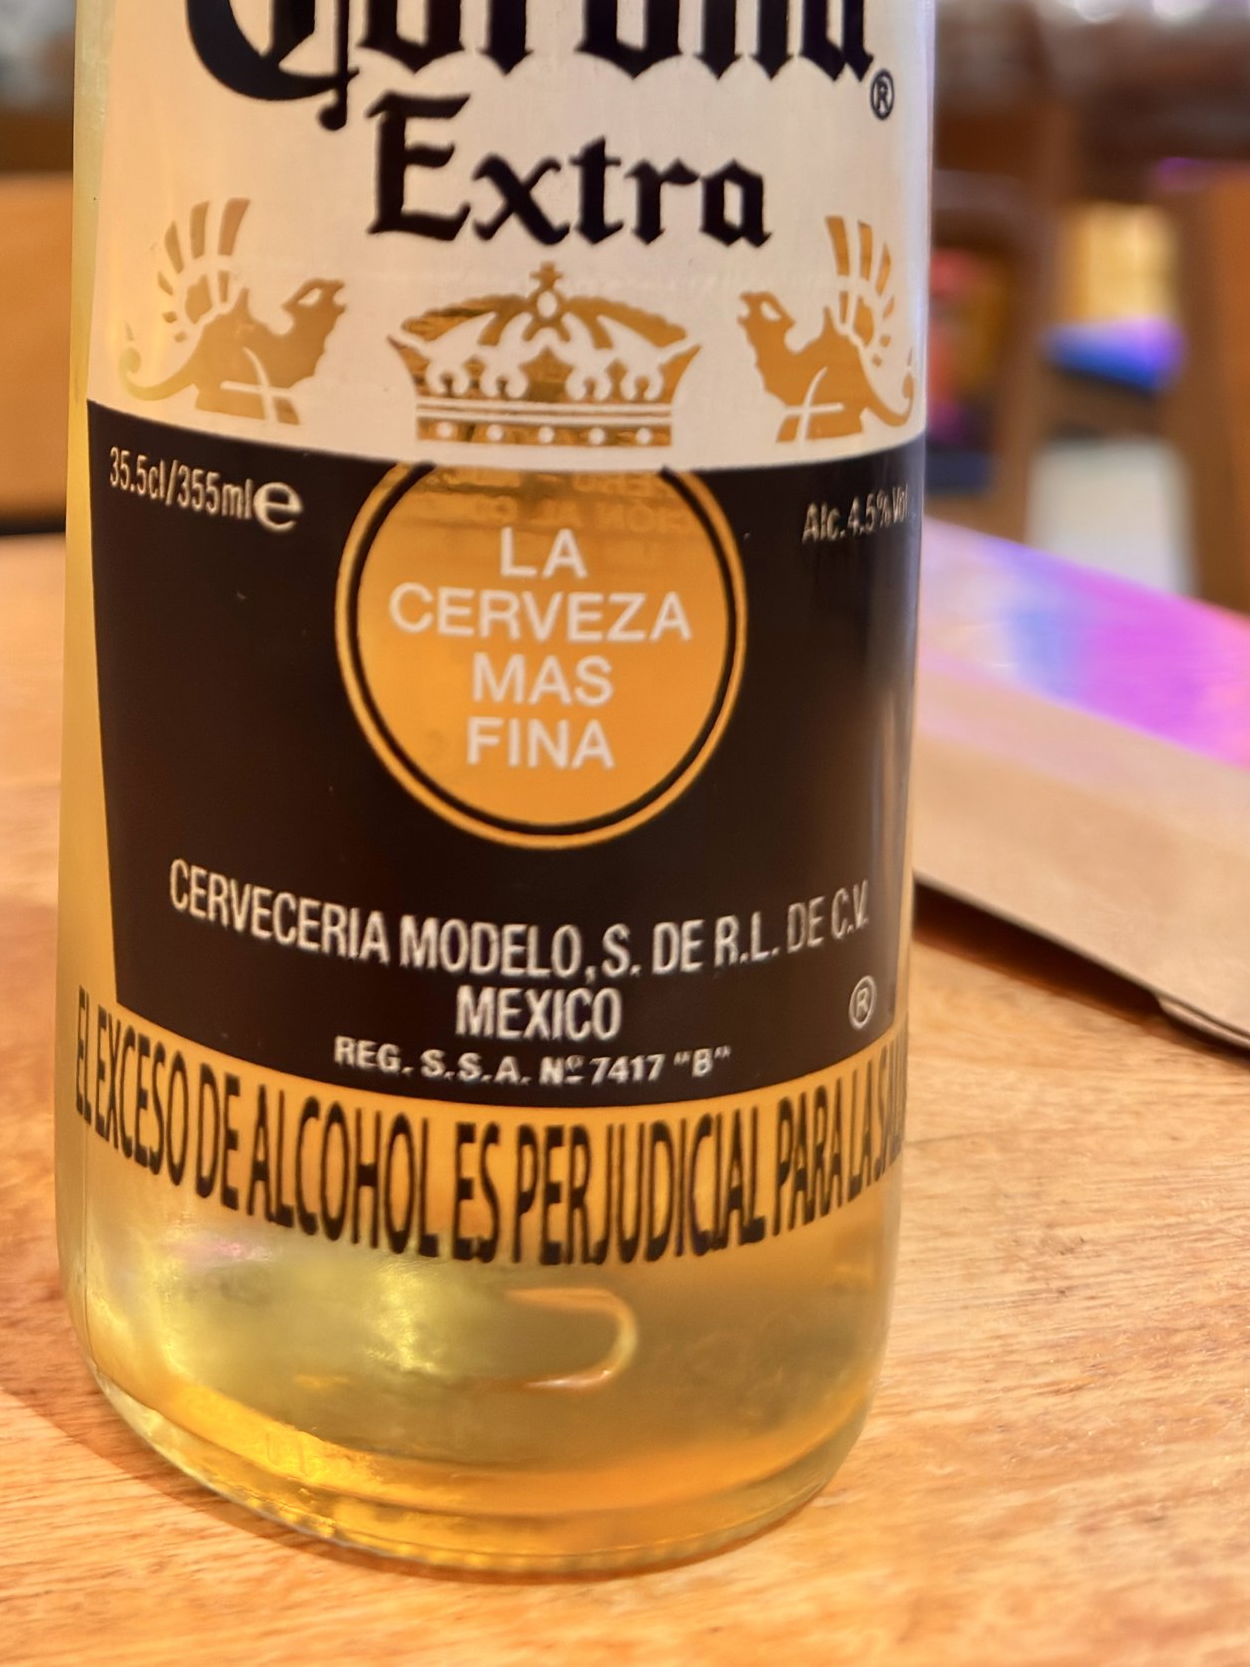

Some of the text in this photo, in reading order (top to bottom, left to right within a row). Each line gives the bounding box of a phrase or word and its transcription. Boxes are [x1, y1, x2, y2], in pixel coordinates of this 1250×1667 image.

[366, 91, 772, 248] Extra
[500, 527, 589, 580] LA
[388, 581, 693, 643] CERVEZA
[471, 653, 615, 707] MAS
[466, 718, 615, 771] FINA
[169, 858, 391, 966] CERVECERIA
[652, 920, 705, 975] DE
[713, 914, 780, 968] R.L.
[787, 896, 825, 954] DE
[454, 984, 623, 1041] MEXICO
[333, 1035, 412, 1077] REG.
[421, 1048, 532, 1084] S.S.A.
[589, 1053, 666, 1085] 7417
[76, 984, 92, 1126] EL
[95, 1004, 190, 1186] EXCESO
[195, 1062, 241, 1211] DE
[246, 1083, 439, 1258] ALCOHOL
[452, 1120, 501, 1264] ES
[511, 1105, 767, 1266] PERJUDICIAL
[772, 1074, 844, 1237] PARA
[847, 1058, 873, 1204] LA
